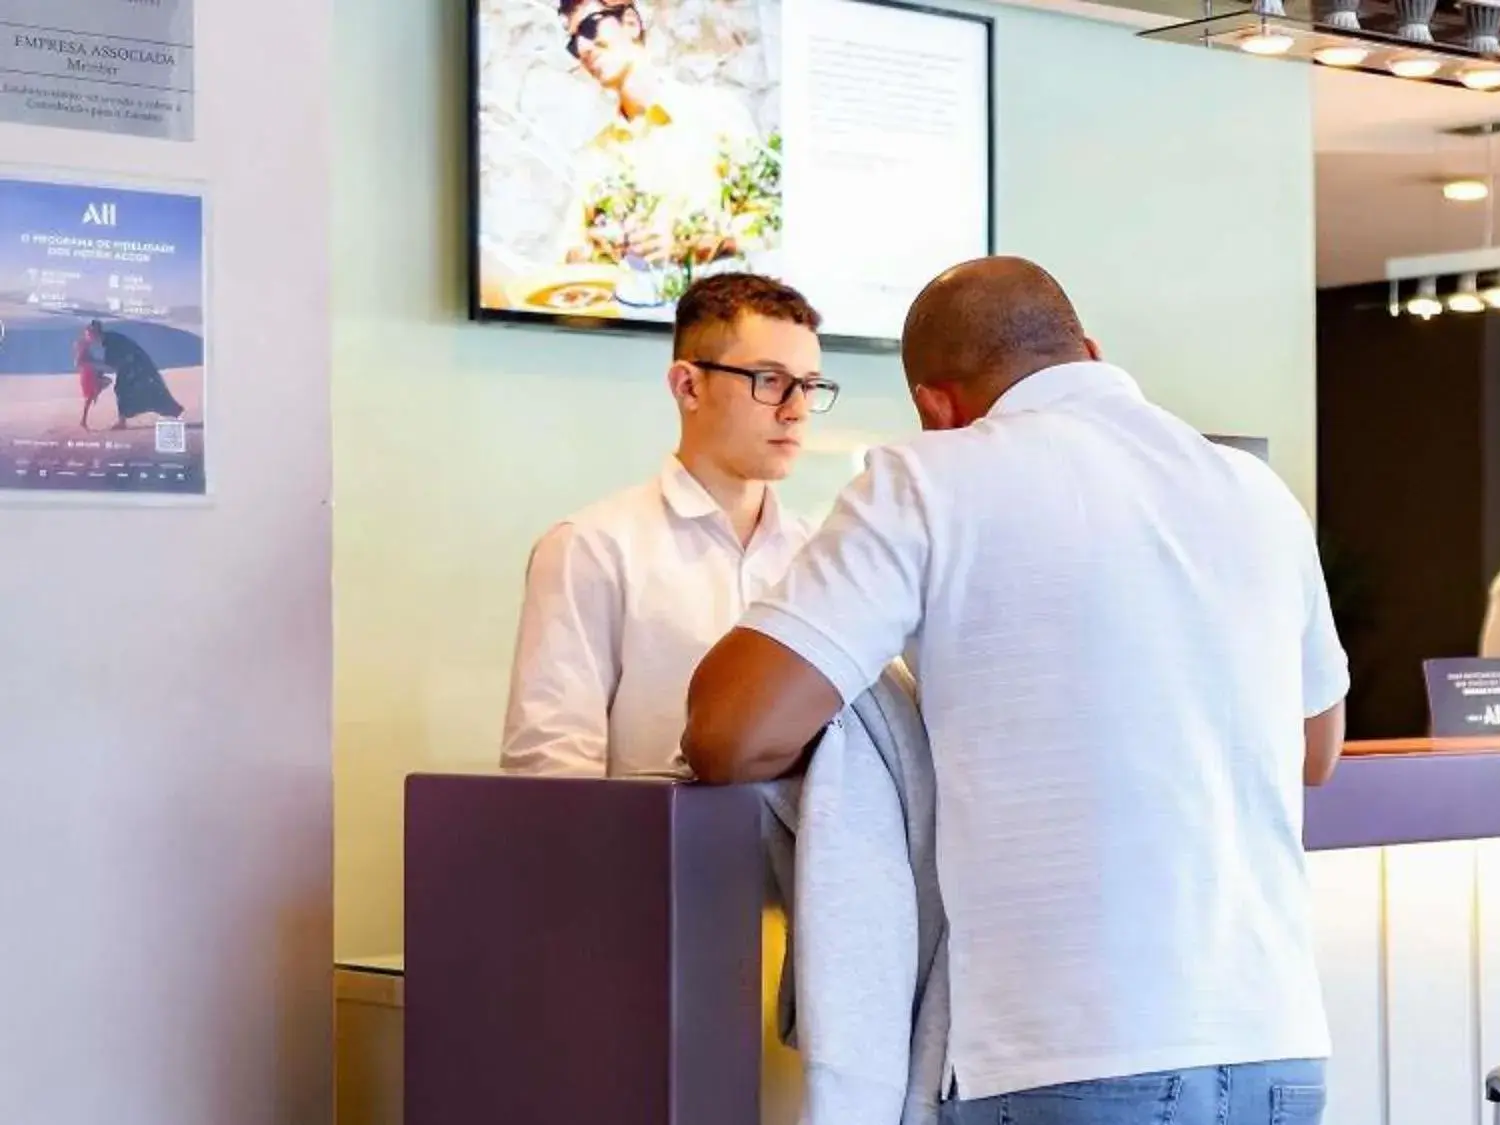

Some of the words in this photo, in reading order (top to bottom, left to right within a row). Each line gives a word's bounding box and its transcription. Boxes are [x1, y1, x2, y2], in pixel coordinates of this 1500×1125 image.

[15, 34, 87, 57] EMPRESA
[91, 45, 175, 65] ASSOCIADA
[82, 202, 117, 226] All
